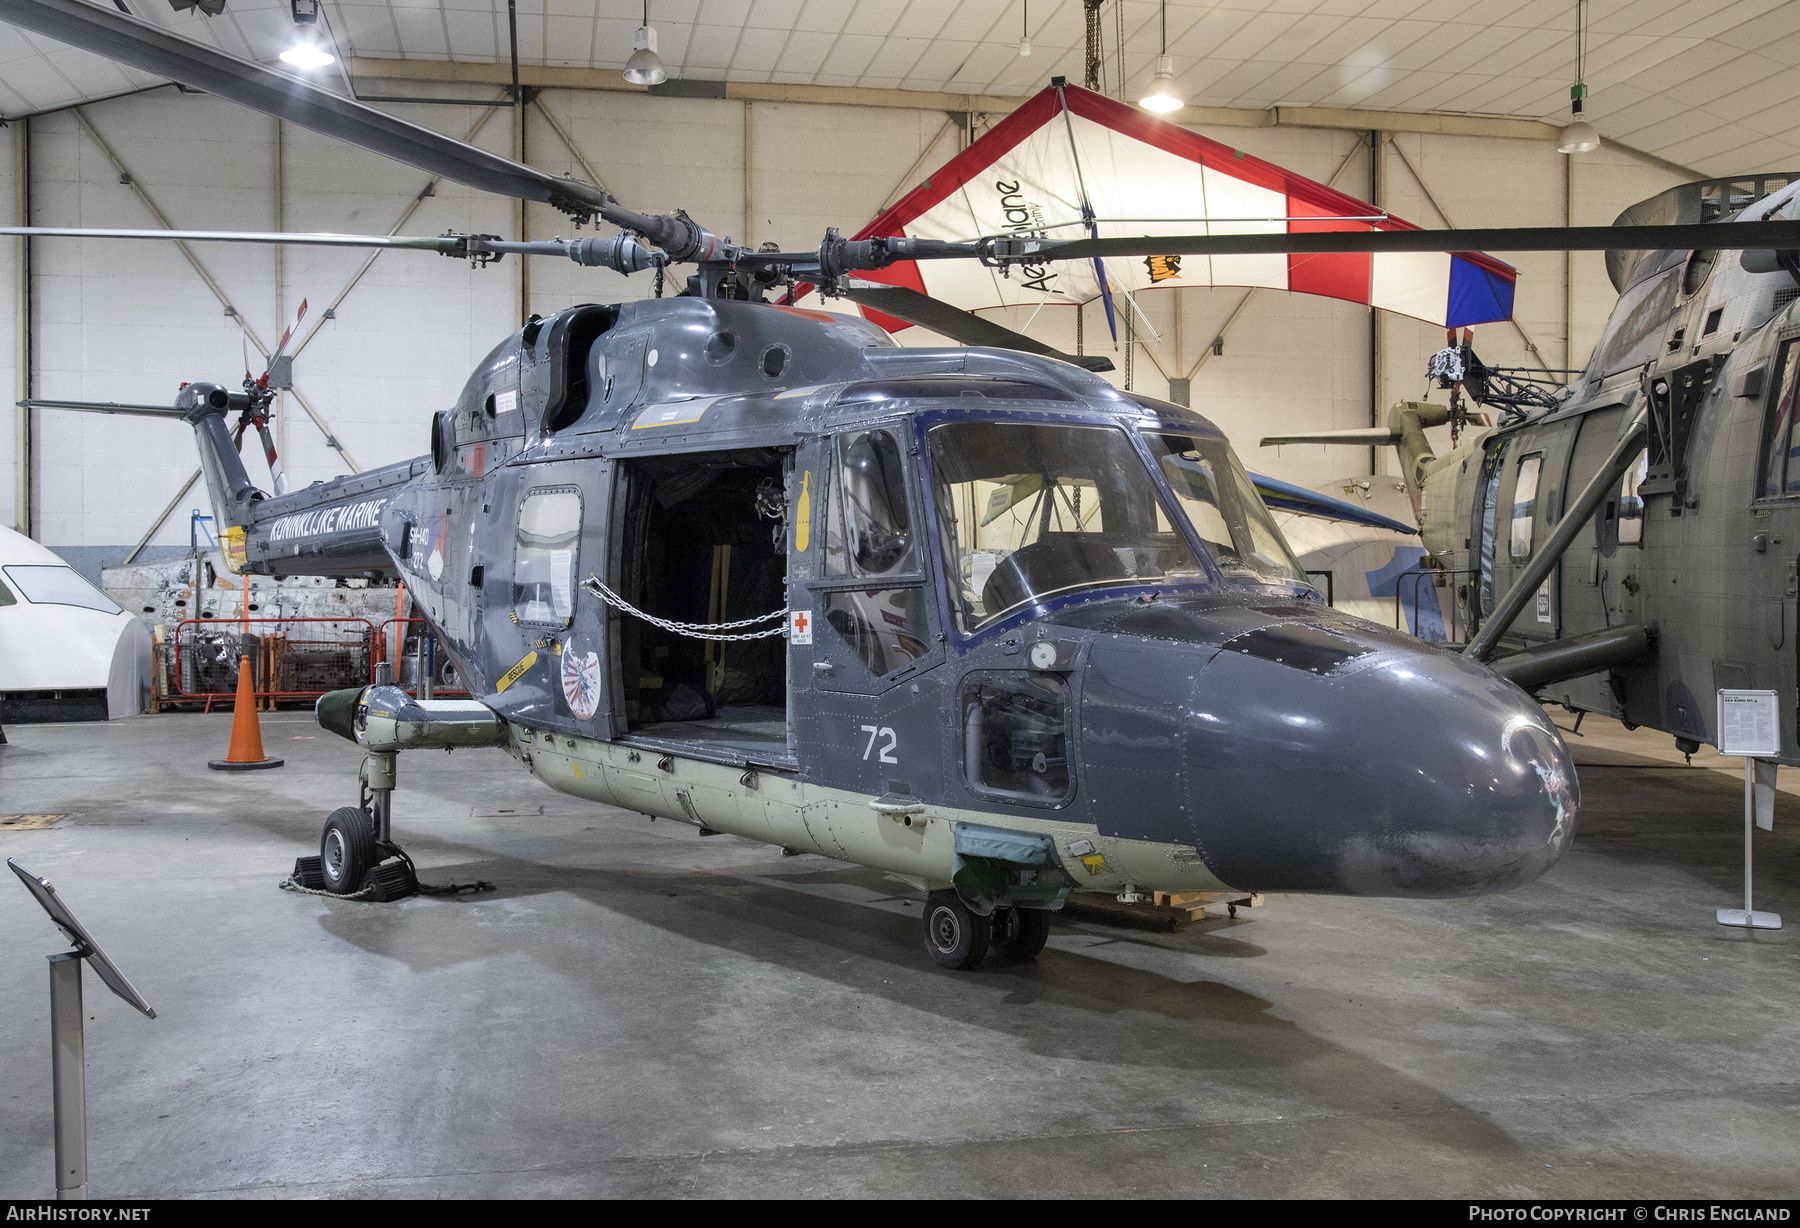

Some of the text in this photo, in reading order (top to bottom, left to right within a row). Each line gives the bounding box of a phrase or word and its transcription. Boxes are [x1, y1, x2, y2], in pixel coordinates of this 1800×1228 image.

[270, 499, 387, 541] KONINKLIJKE MARINE
[507, 661, 525, 682] RESCUE
[861, 725, 898, 764] 72
